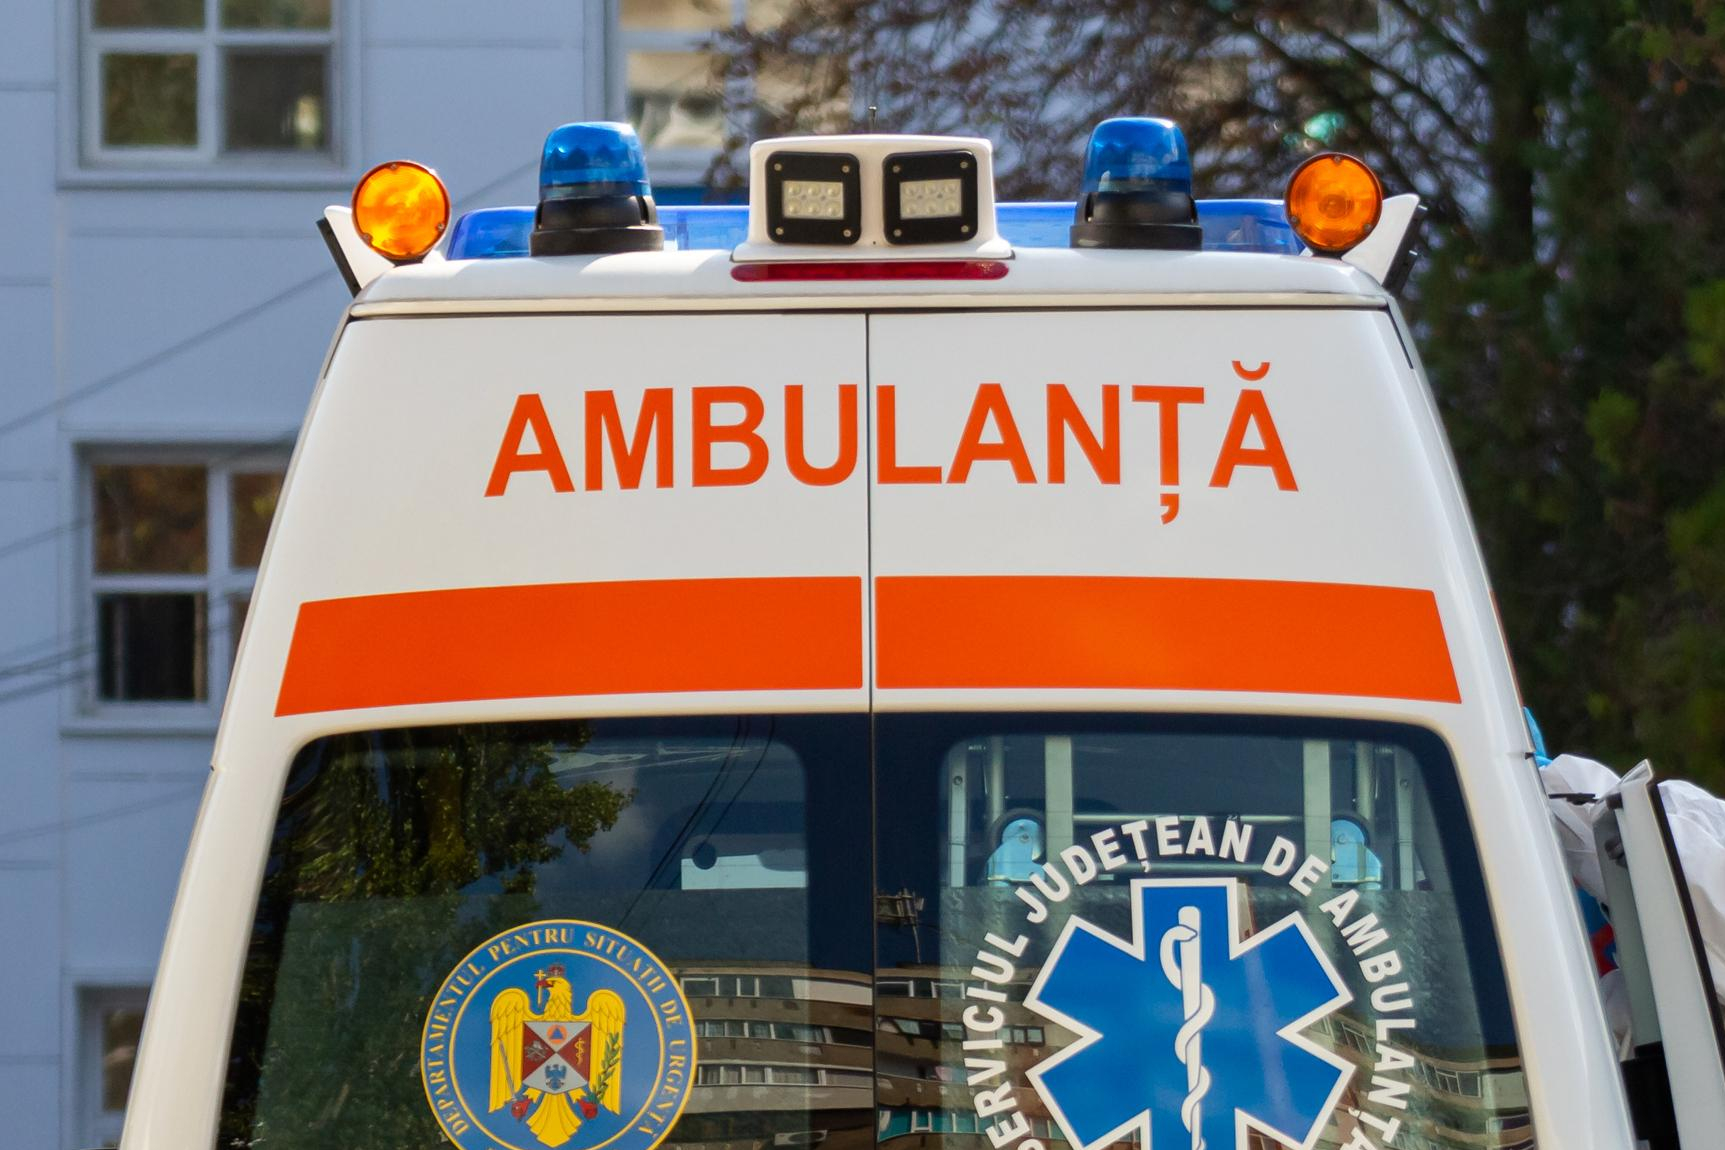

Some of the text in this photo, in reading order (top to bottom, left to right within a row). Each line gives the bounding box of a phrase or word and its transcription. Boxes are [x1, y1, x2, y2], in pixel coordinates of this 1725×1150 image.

[484, 361, 1299, 525] AMBULANȚĂ
[1015, 815, 1253, 925] JUDEȚEAN
[1262, 836, 1329, 896] DE
[427, 961, 486, 1137] DEPARTAMENTUL
[487, 928, 574, 962] PENTRU
[660, 999, 684, 1029] DE
